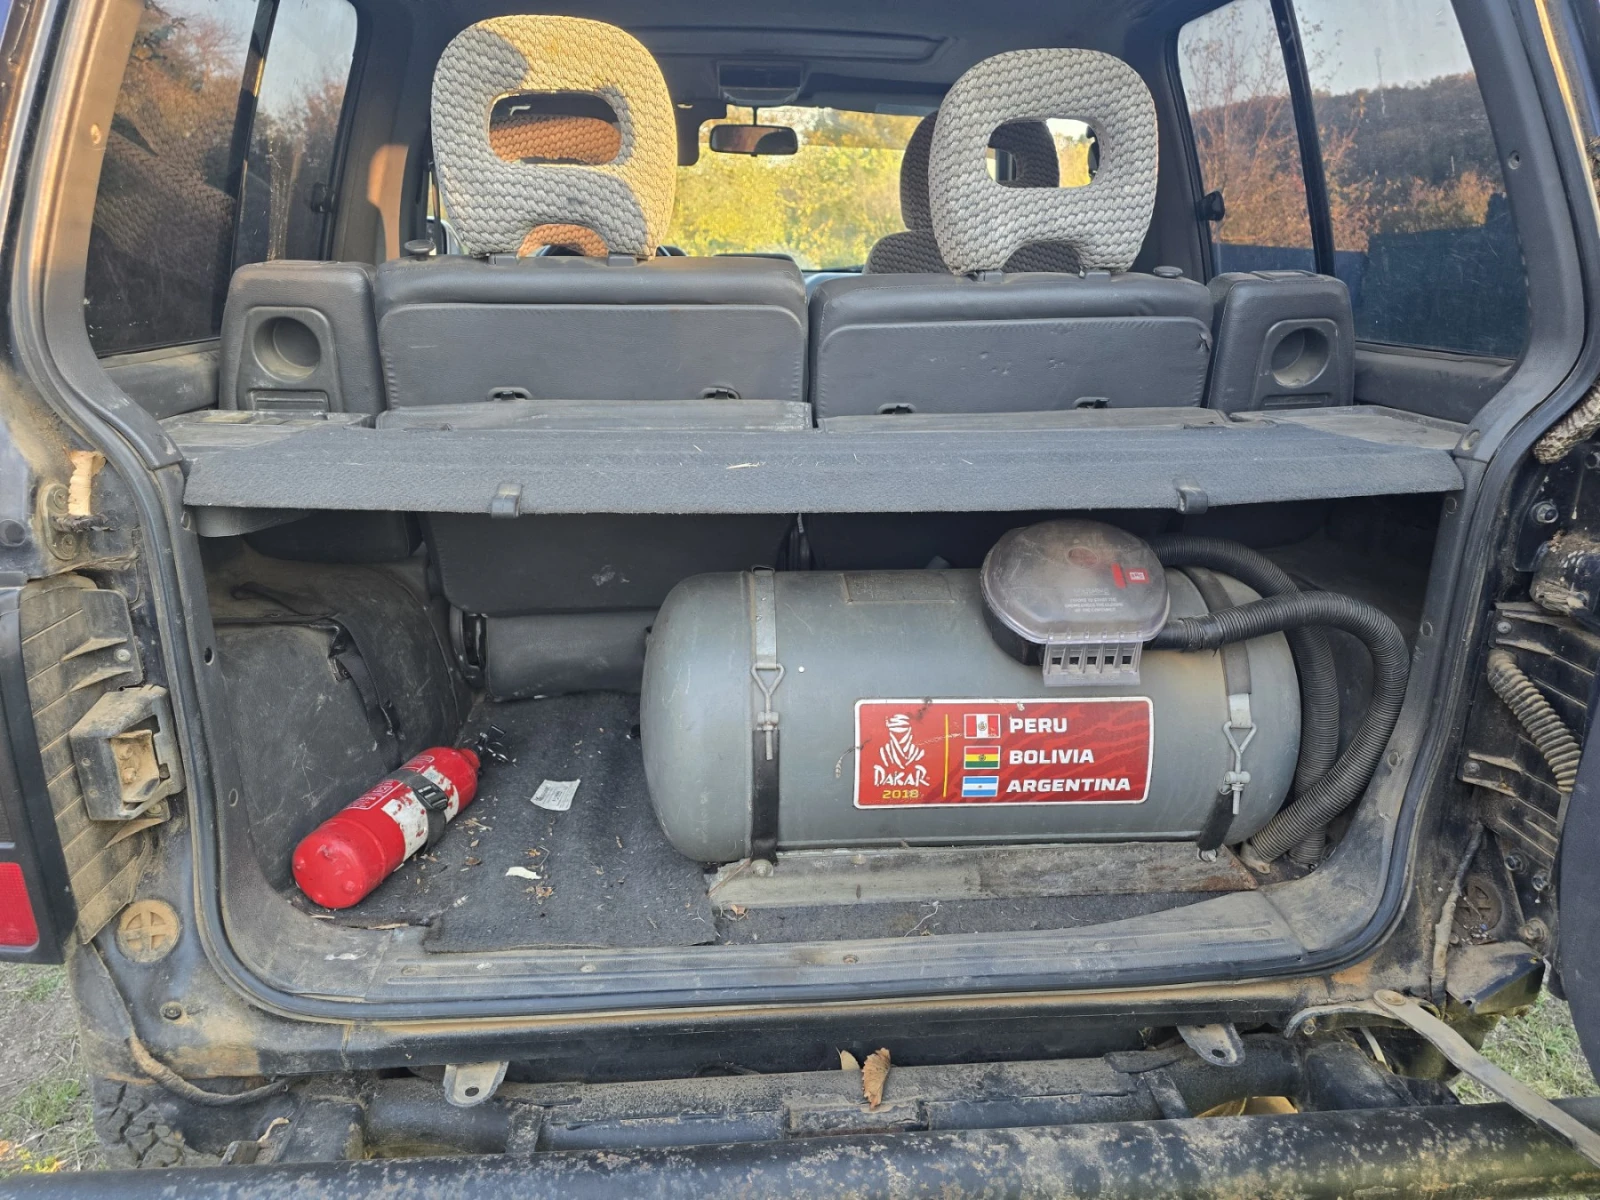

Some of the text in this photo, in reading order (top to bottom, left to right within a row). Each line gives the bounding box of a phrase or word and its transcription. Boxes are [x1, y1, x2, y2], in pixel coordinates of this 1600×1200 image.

[1009, 717, 1067, 733] PERU
[1009, 749, 1095, 764] BOLIVIA
[873, 764, 930, 787] DAKAR
[1006, 778, 1131, 792] ARGENTINA
[882, 789, 919, 799] 2018
